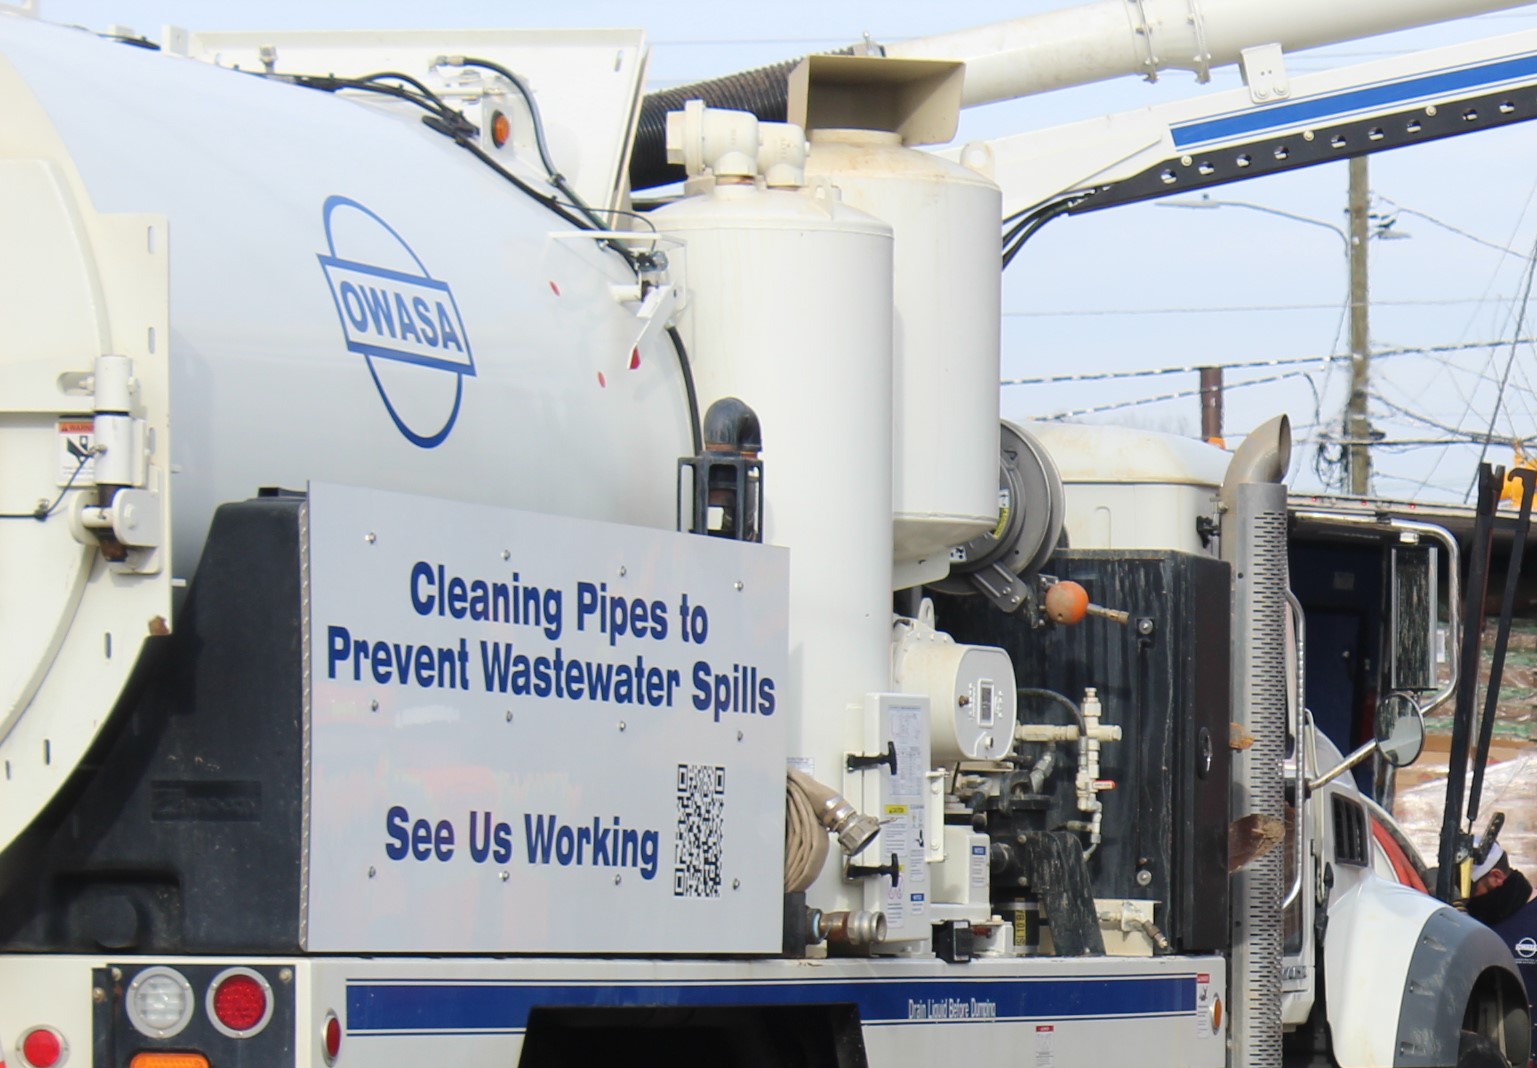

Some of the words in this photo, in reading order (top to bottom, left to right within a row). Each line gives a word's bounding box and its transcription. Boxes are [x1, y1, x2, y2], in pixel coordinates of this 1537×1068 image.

[340, 280, 464, 353] OWASA
[410, 561, 563, 641] Cleaning
[576, 581, 669, 646] Pipes
[680, 593, 709, 645] to
[327, 625, 469, 691] Prevent
[480, 640, 681, 708] Wastewater
[692, 661, 777, 723] Spills
[385, 805, 456, 863] See
[469, 811, 513, 865] Us
[524, 813, 660, 881] Working
[949, 998, 969, 1019] Before
